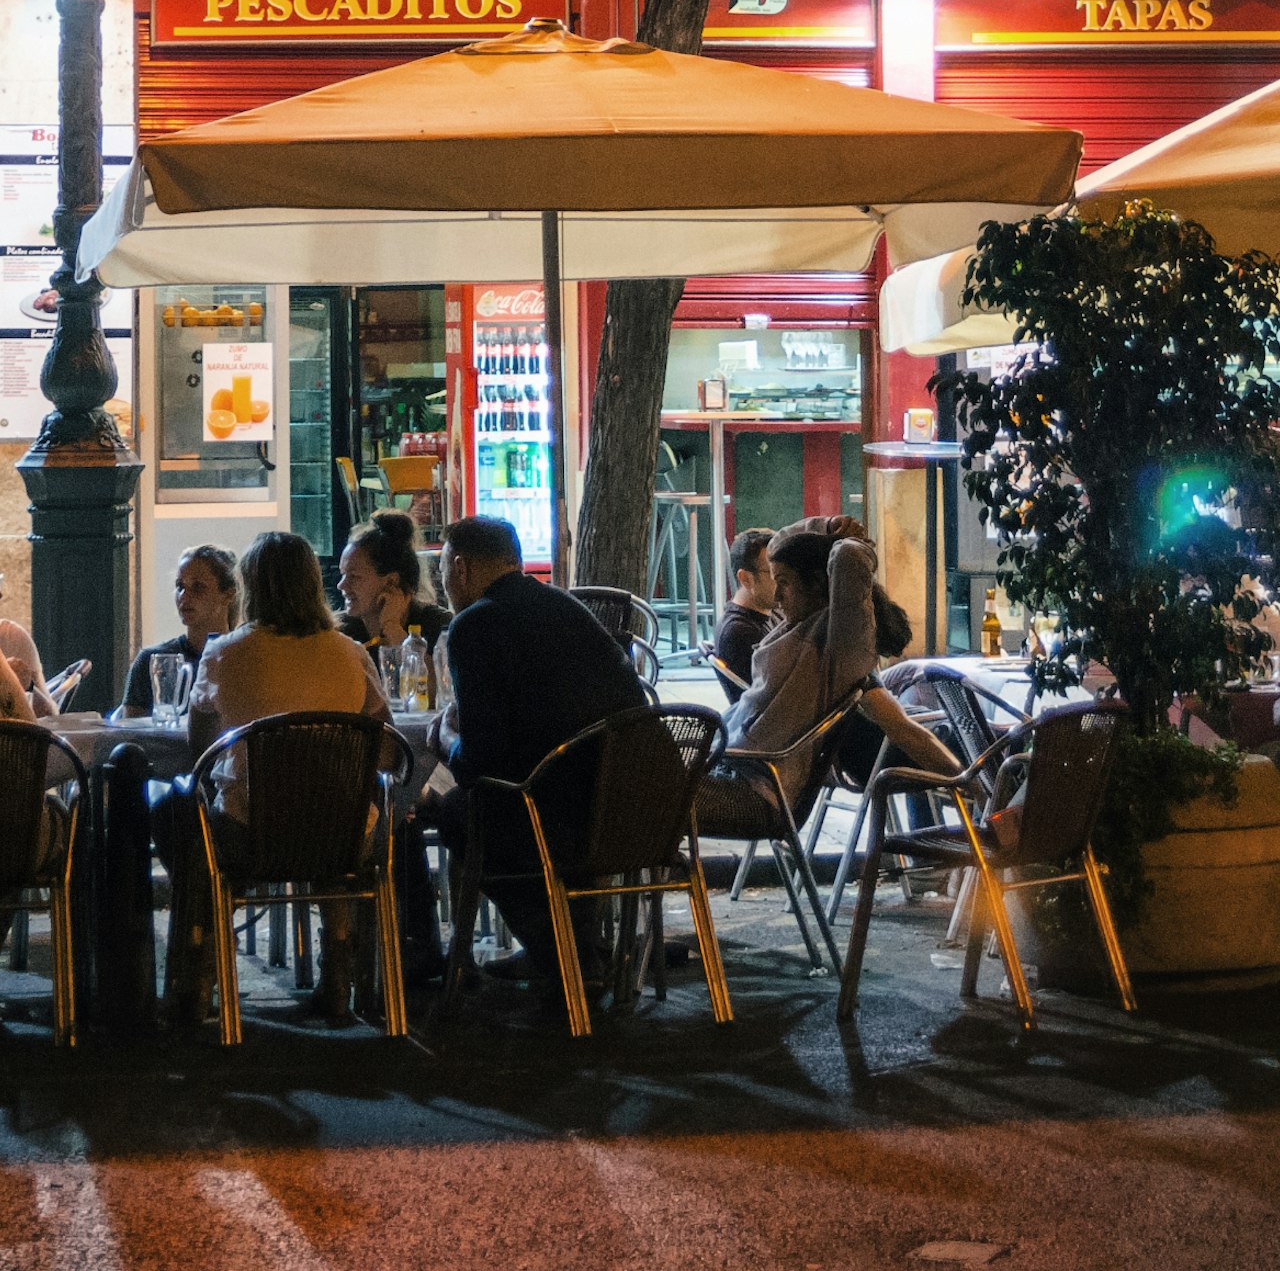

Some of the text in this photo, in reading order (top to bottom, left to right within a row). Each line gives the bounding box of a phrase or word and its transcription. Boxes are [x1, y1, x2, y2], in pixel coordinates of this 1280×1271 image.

[477, 290, 545, 318] Coca-Cola
[228, 345, 248, 353] ZUMO
[233, 354, 244, 362] DE
[207, 362, 270, 371] NARANJA NATURAL
